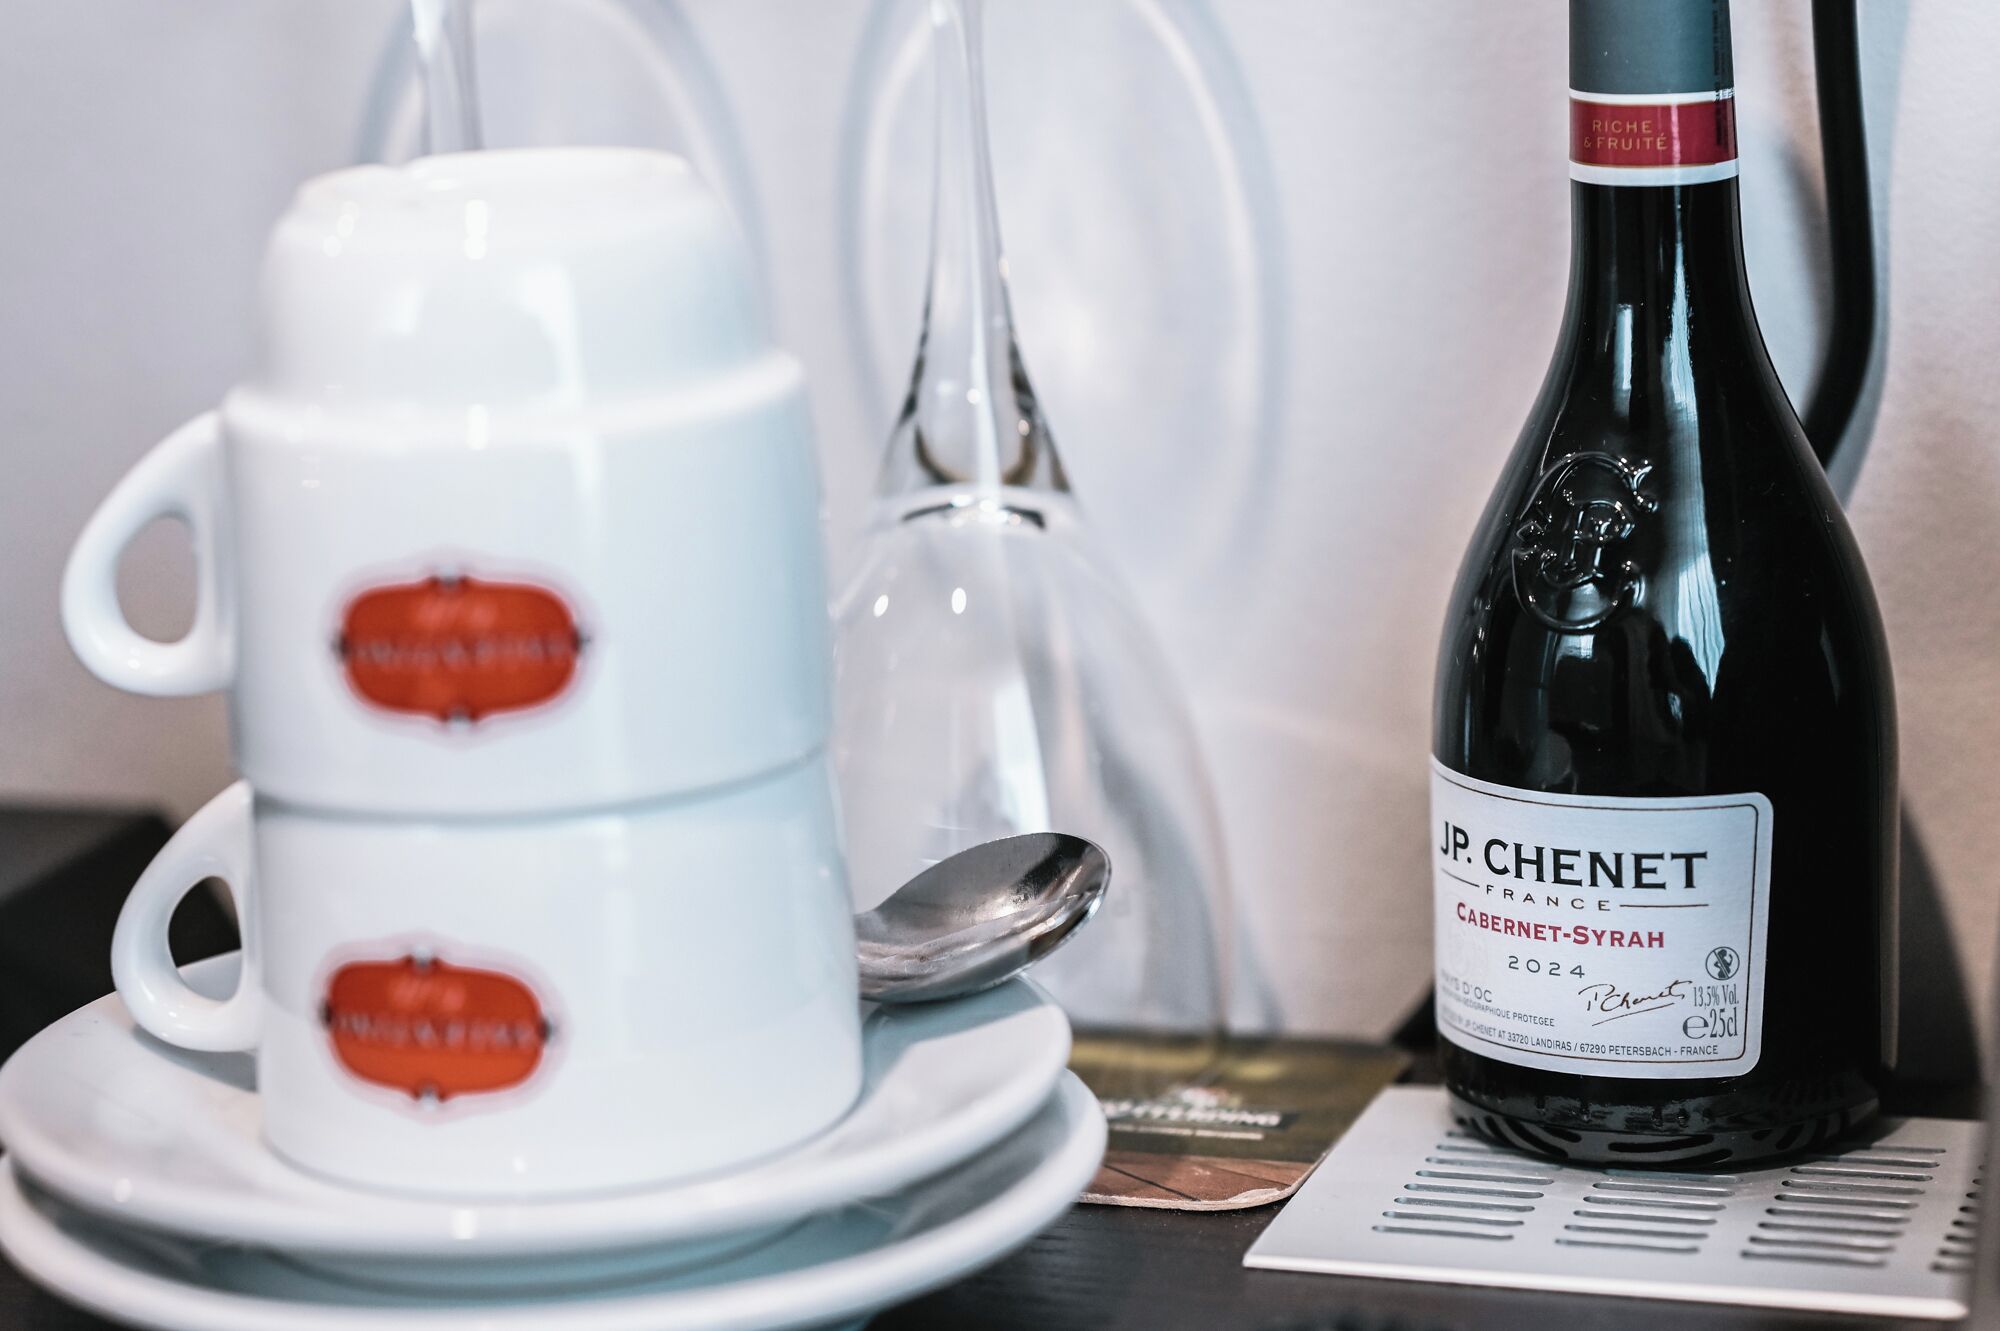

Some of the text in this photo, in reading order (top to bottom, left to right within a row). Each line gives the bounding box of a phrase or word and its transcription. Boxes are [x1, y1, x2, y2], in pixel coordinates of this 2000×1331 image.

[1592, 120, 1652, 134] RICHE
[1584, 133, 1668, 150] & FRUITÉ
[1441, 821, 1708, 890] JP. CHENET
[1486, 885, 1610, 912] FRANCE
[1508, 955, 1585, 978] 2024
[1693, 984, 1739, 1009] 13,5% Vol.
[1709, 1006, 1738, 1038] 25cl
[1507, 1031, 1529, 1045] 33720
[1531, 1036, 1572, 1052] LANDIRAS
[1580, 1043, 1606, 1054] 67290
[1609, 1045, 1671, 1057] PETERSBACH
[1680, 1045, 1719, 1056] FRANCE
